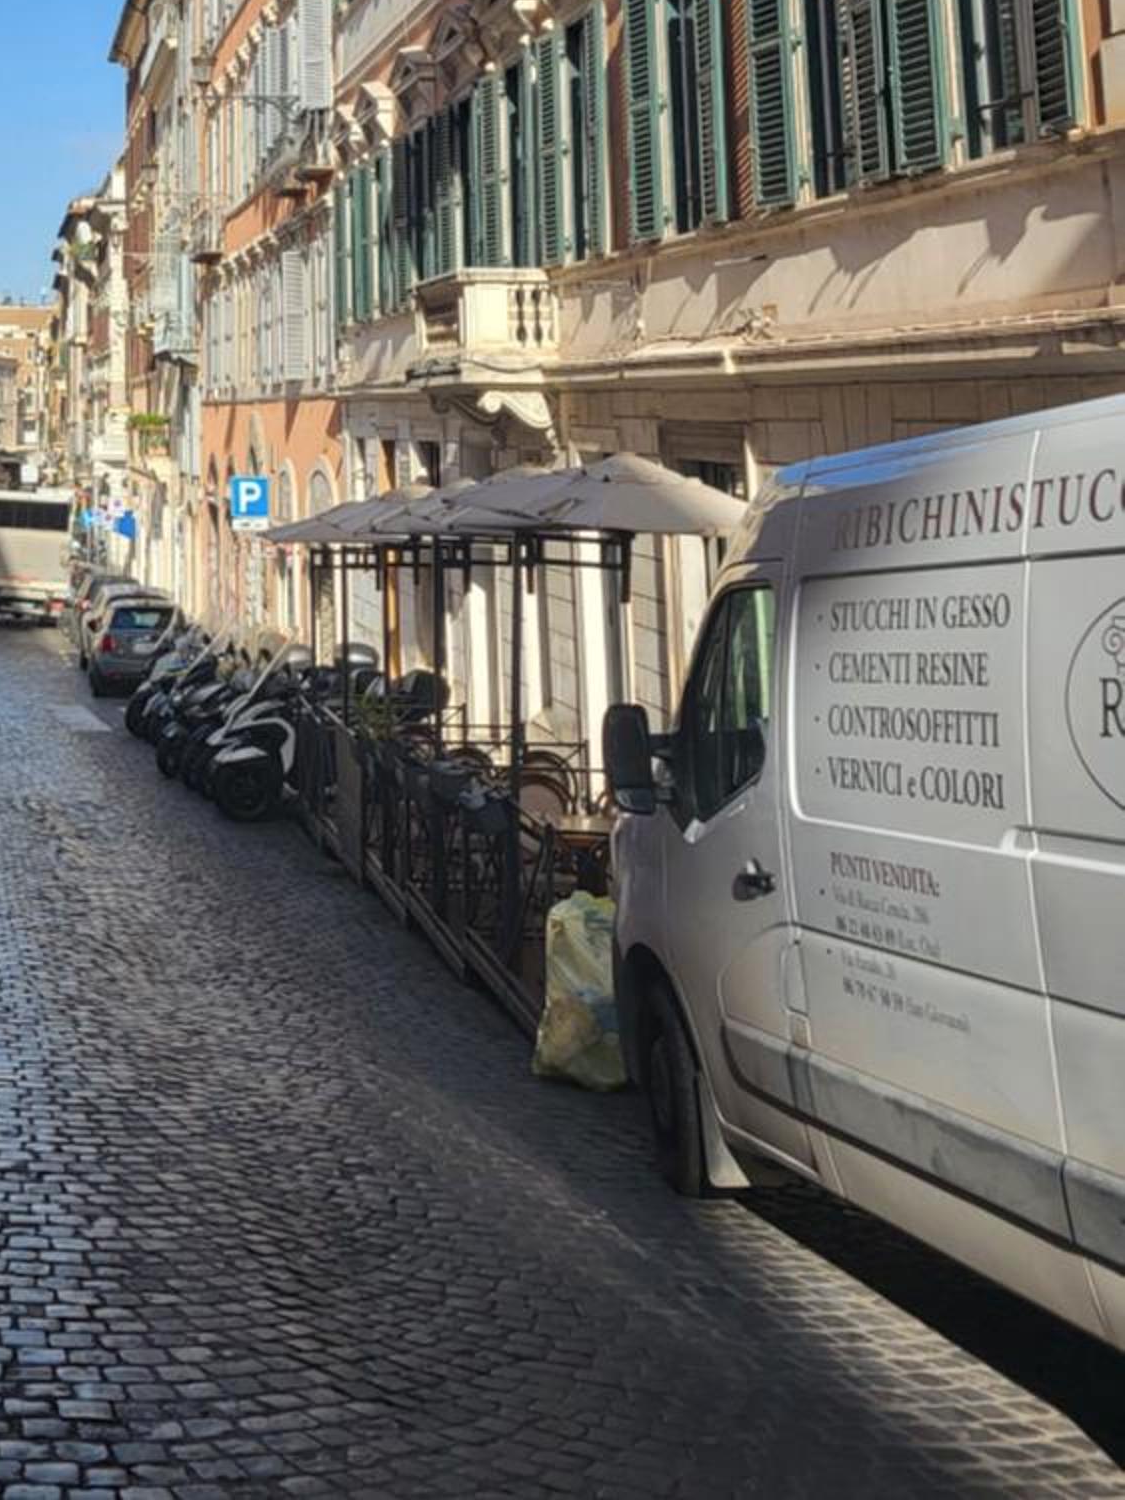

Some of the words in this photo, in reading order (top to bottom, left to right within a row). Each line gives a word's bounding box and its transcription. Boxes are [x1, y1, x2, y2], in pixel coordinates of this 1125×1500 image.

[239, 481, 262, 513] P
[830, 599, 911, 632] STUCCHI
[915, 596, 938, 629] IN
[942, 593, 1011, 629] GESSO
[828, 651, 911, 685] CEMENTI
[916, 652, 989, 687] RESINE
[828, 704, 999, 748] CONTROSOFFITTI
[828, 756, 902, 796] VERNICI
[906, 776, 917, 798] e
[920, 765, 1005, 810] COLORI
